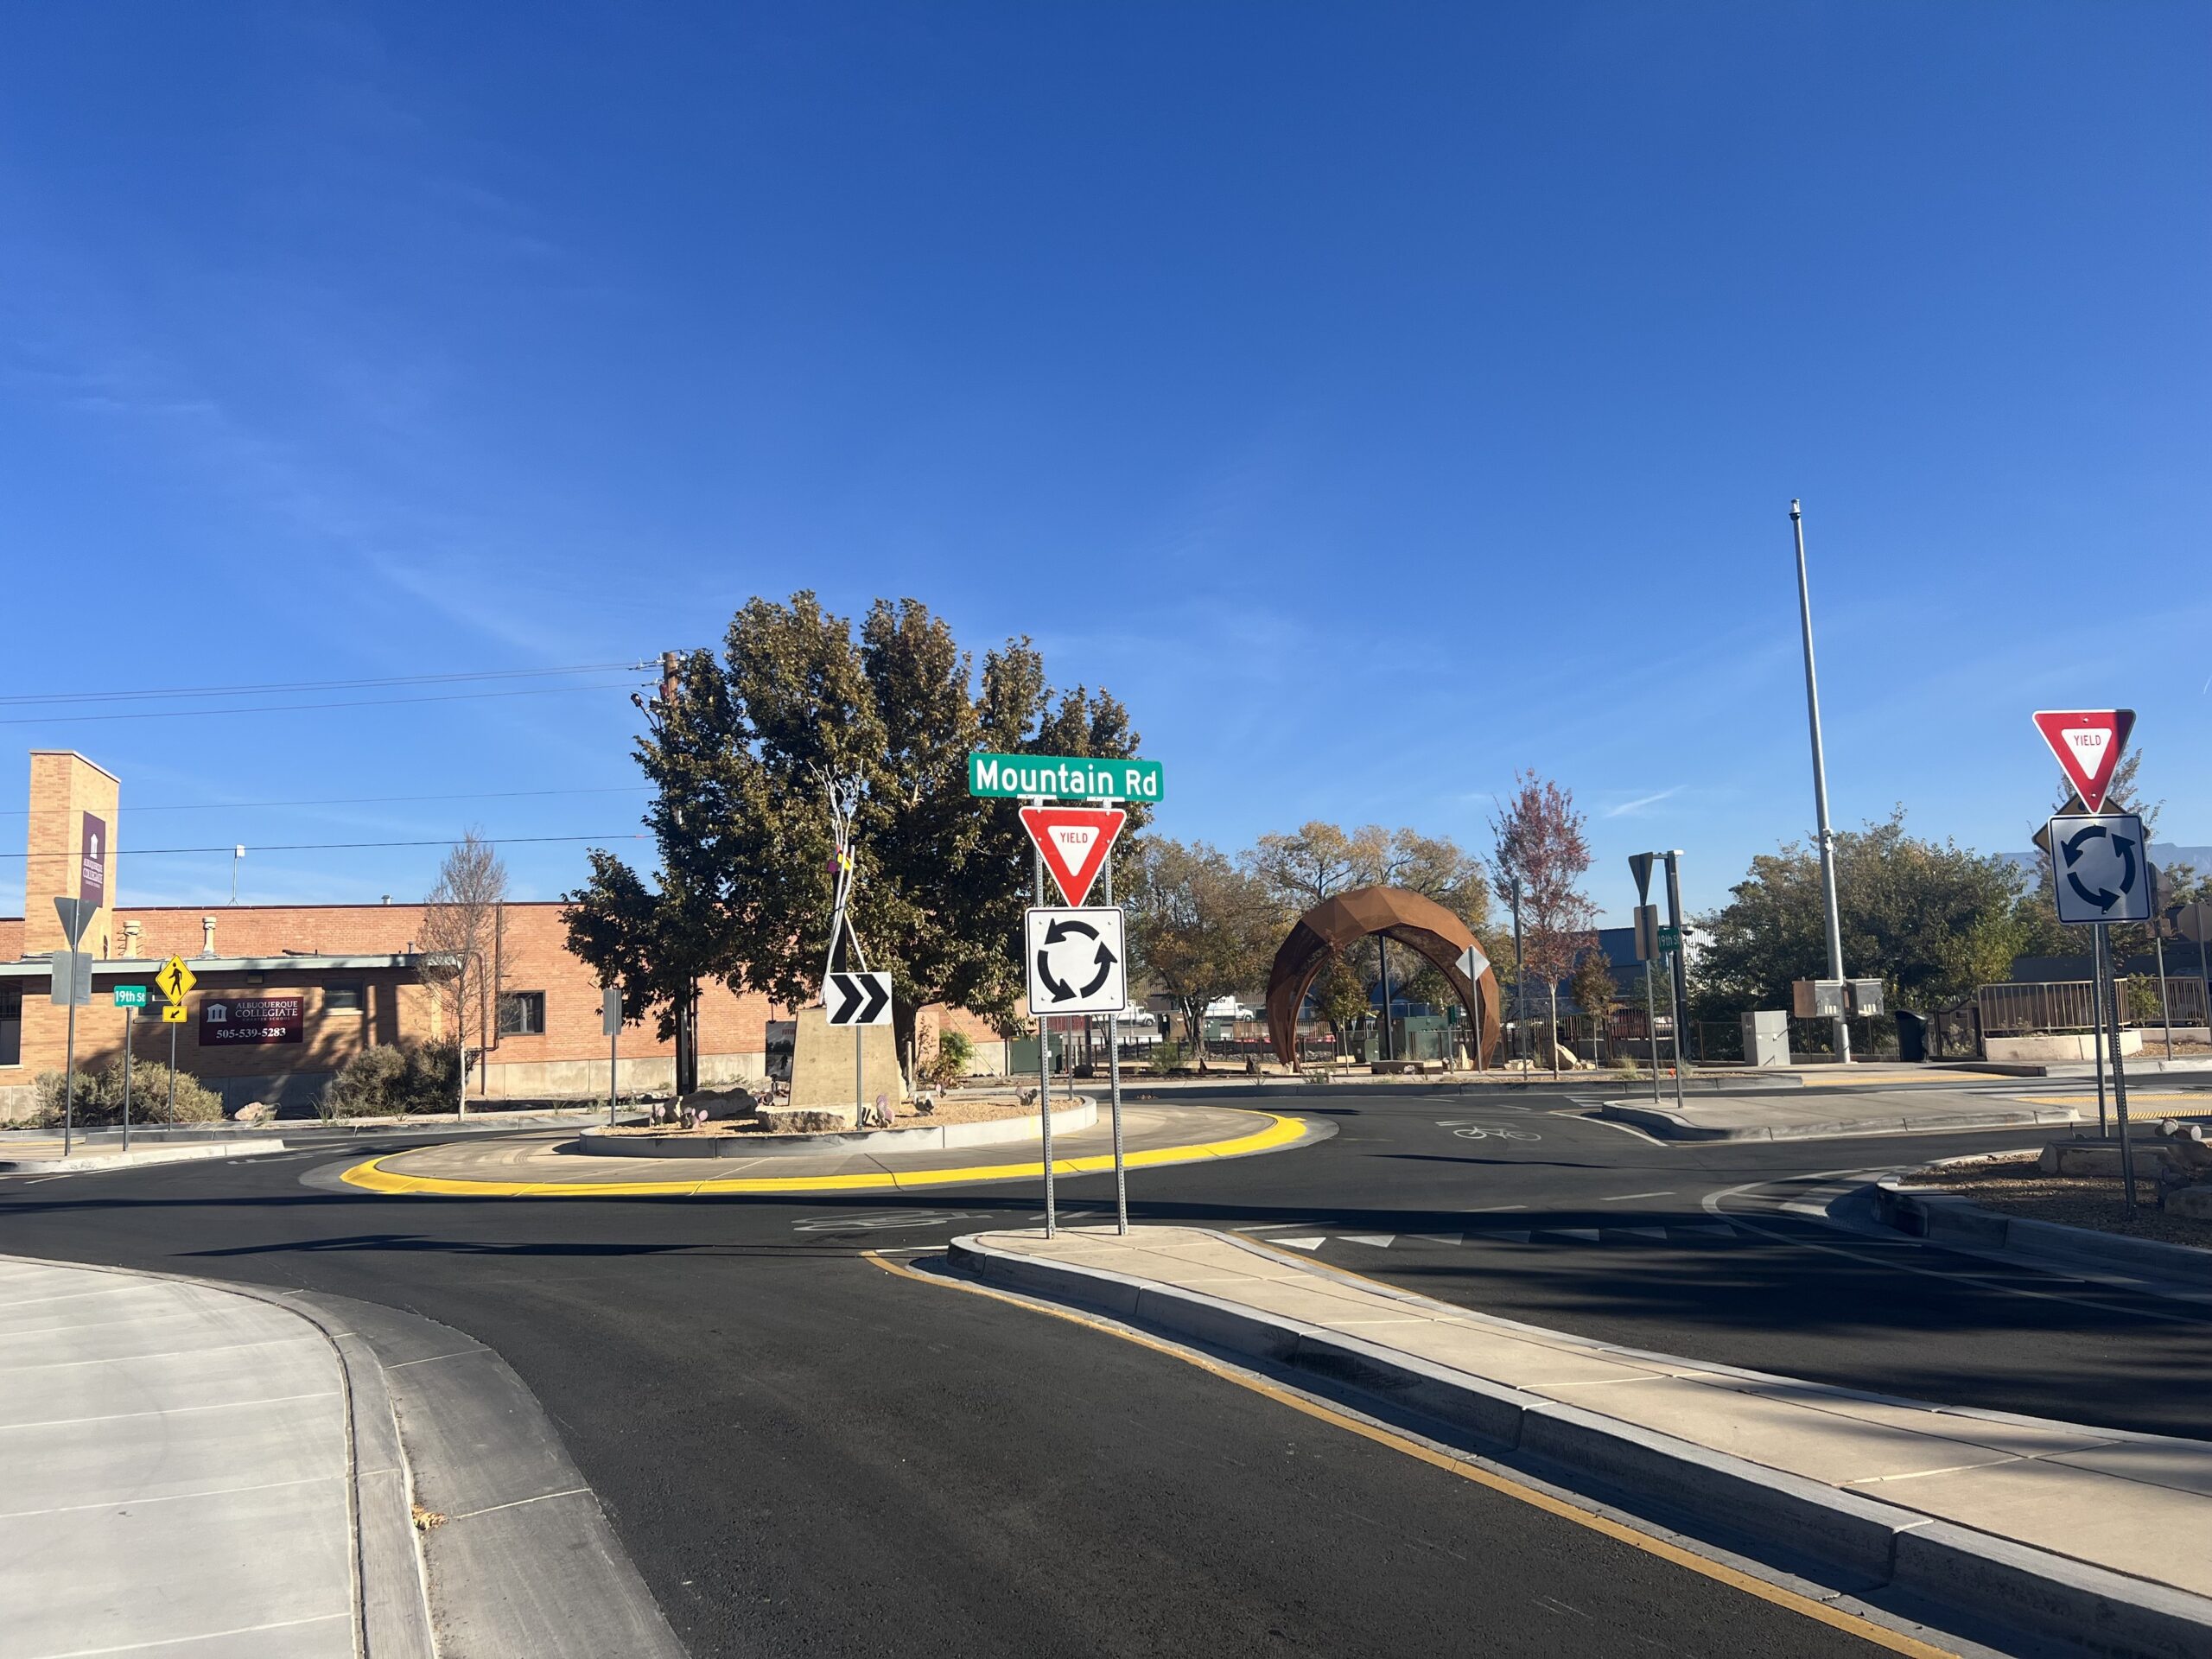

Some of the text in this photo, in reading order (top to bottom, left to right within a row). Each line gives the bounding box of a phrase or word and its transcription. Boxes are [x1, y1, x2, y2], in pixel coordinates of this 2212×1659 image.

[2074, 734, 2101, 746] YIELD
[976, 759, 1158, 797] Mountain Rd
[1059, 832, 1089, 843] YIELD
[1658, 934, 1673, 947] 19th
[115, 990, 145, 1002] 19th St
[235, 1008, 298, 1018] COLLEGIATE
[216, 1028, 286, 1038] 505-539-5283
